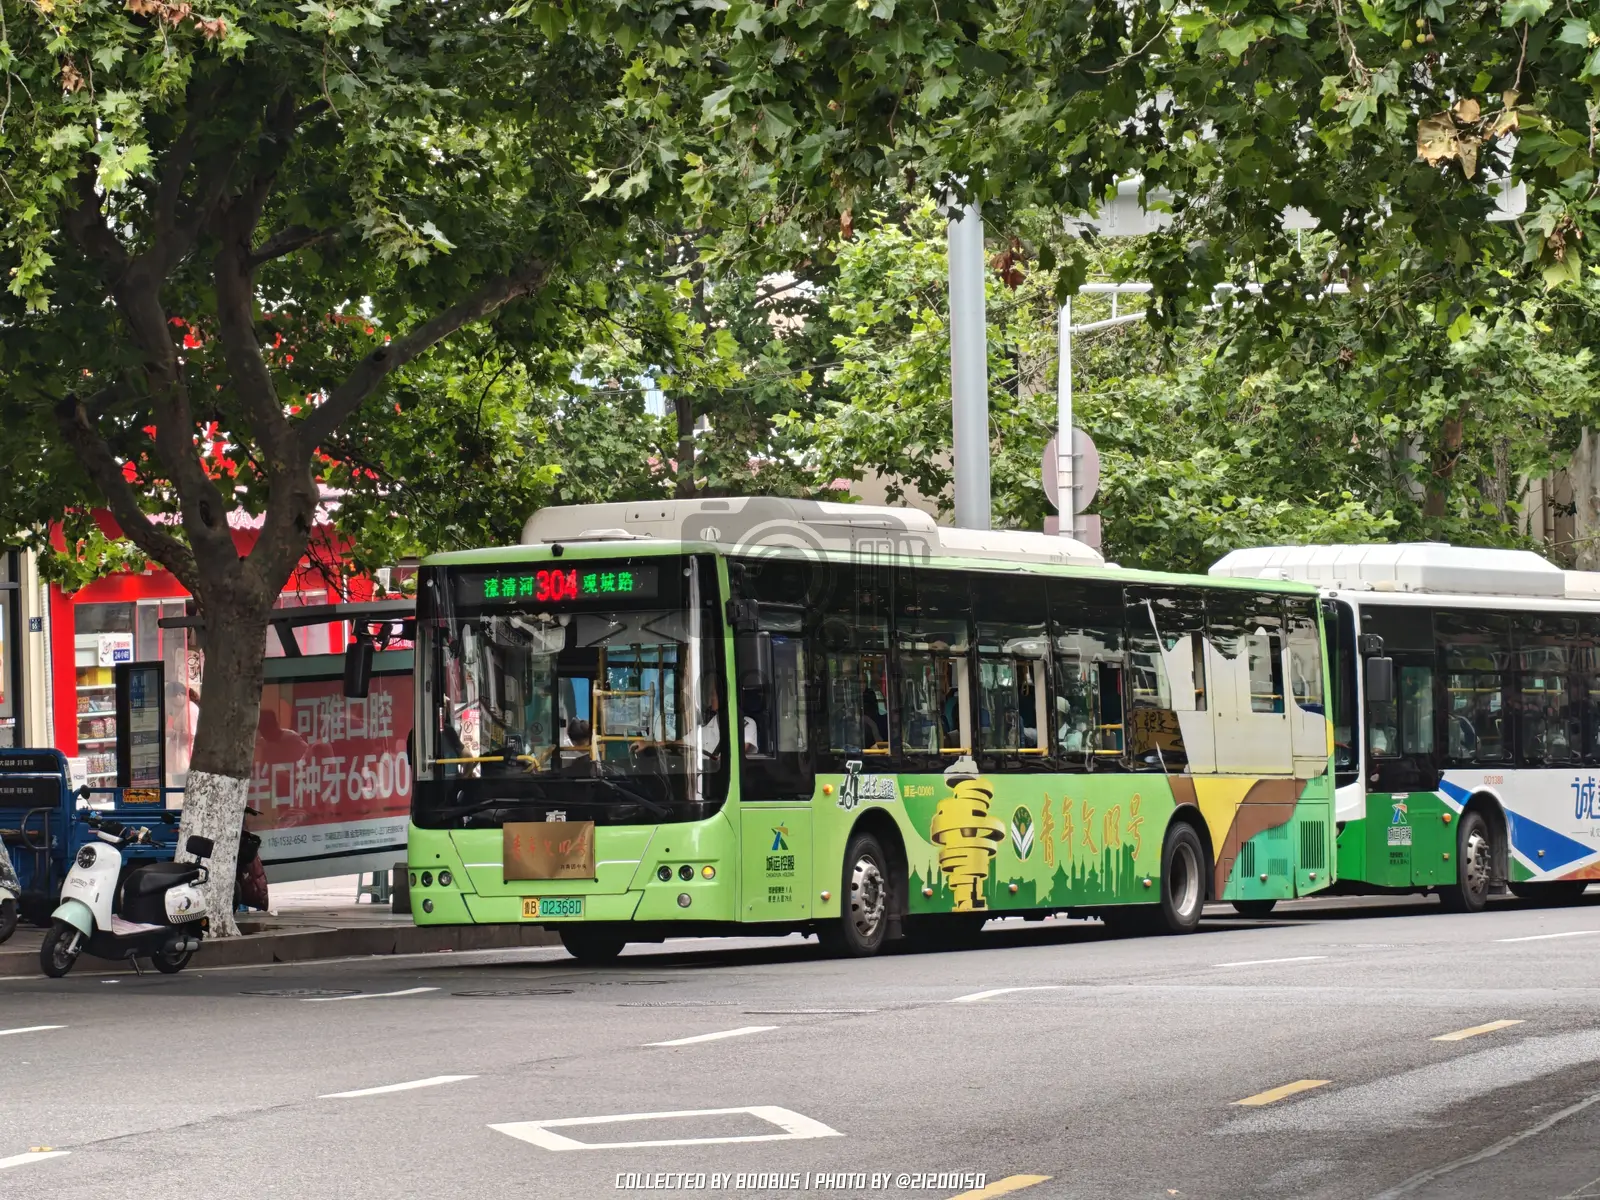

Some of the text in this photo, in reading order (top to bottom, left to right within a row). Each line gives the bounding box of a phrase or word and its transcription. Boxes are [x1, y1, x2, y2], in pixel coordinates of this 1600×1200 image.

[536, 569, 578, 601] 304
[295, 690, 393, 744] 可雅口腔
[247, 751, 410, 813] 半口种牙6500
[1570, 775, 1600, 820] 诚
[1040, 791, 1145, 868] 青年文明号
[766, 855, 795, 871] 城运控股
[541, 900, 582, 915] 02368D
